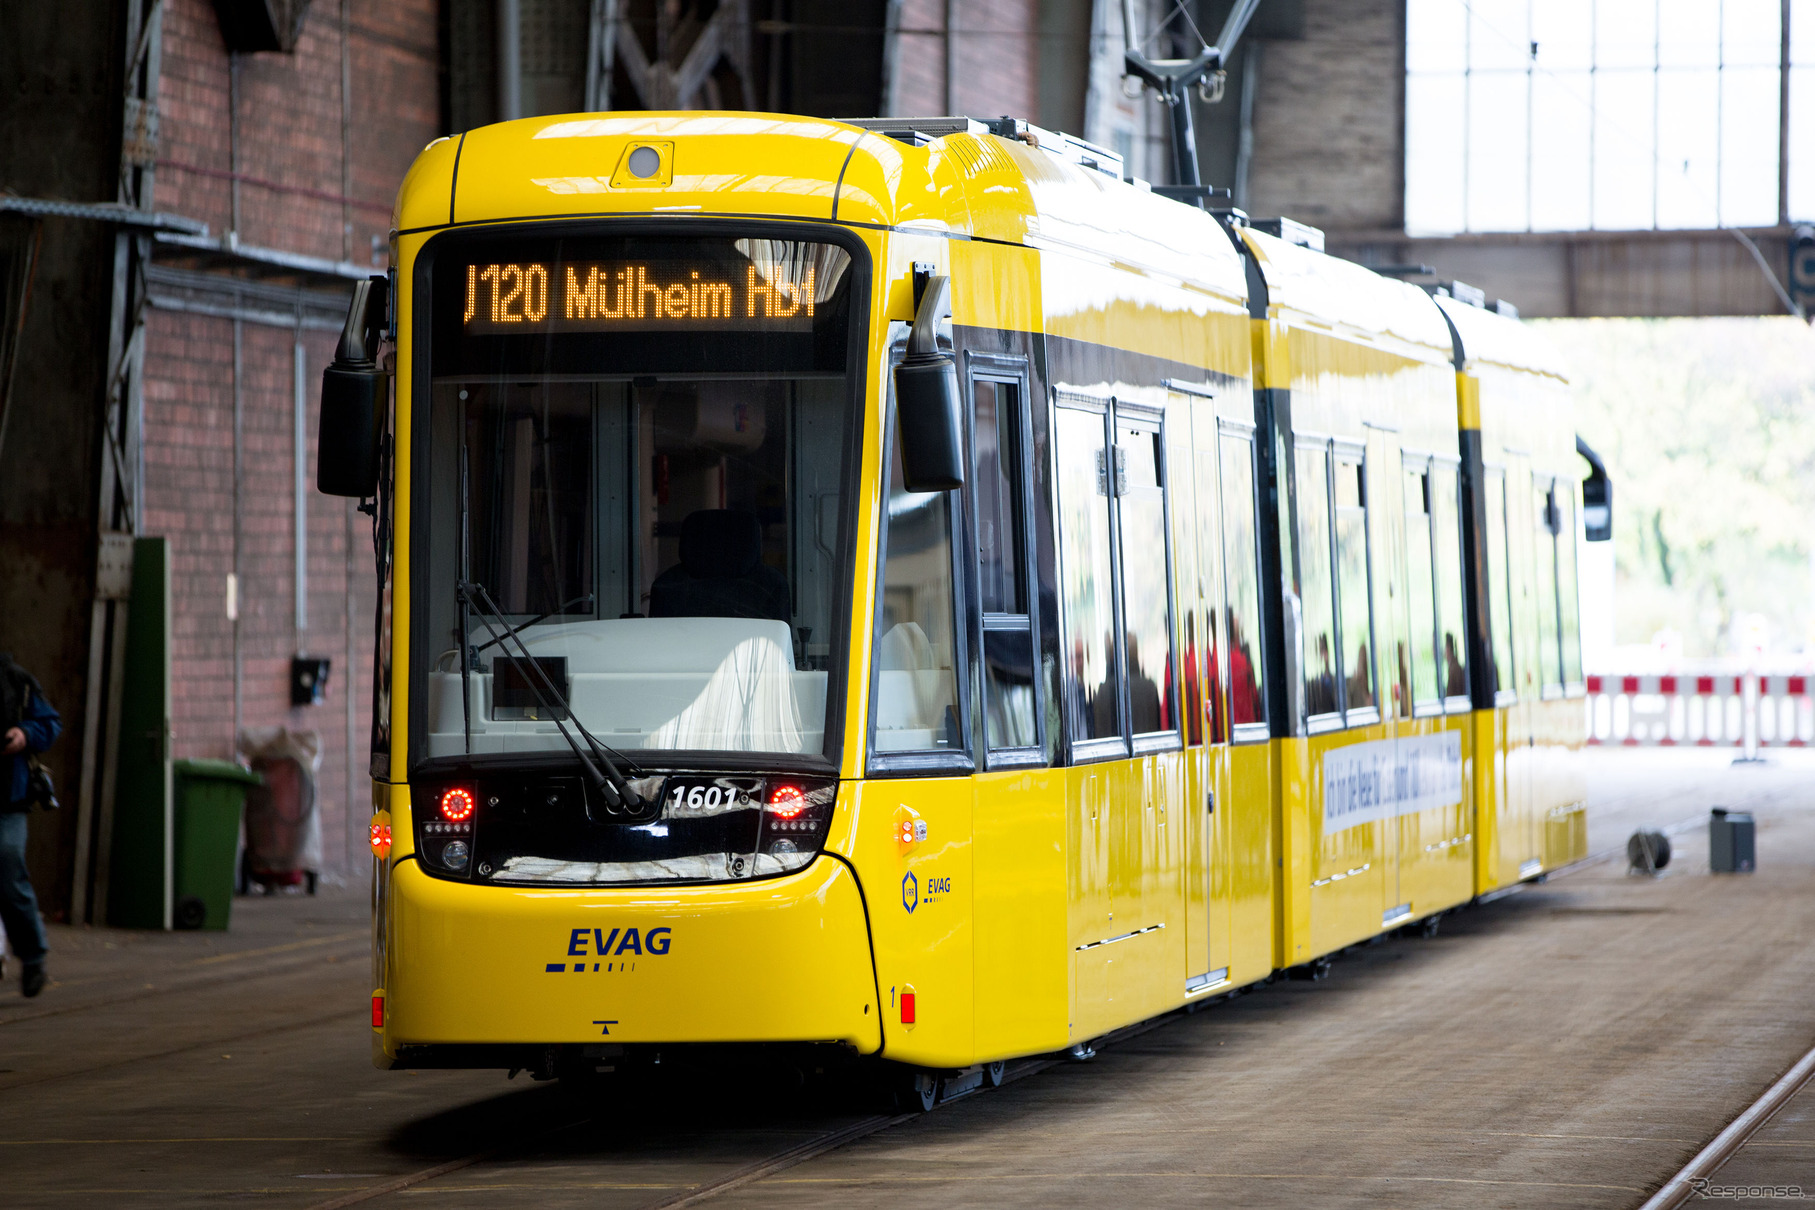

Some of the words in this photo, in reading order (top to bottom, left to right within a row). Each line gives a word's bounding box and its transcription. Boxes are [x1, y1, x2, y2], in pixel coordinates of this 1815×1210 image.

[566, 266, 732, 319] Mülheim
[672, 785, 737, 811] 1601
[905, 888, 915, 897] VRR
[928, 877, 951, 894] EVAG
[567, 927, 672, 956] EVAG
[890, 986, 895, 1008] 1
